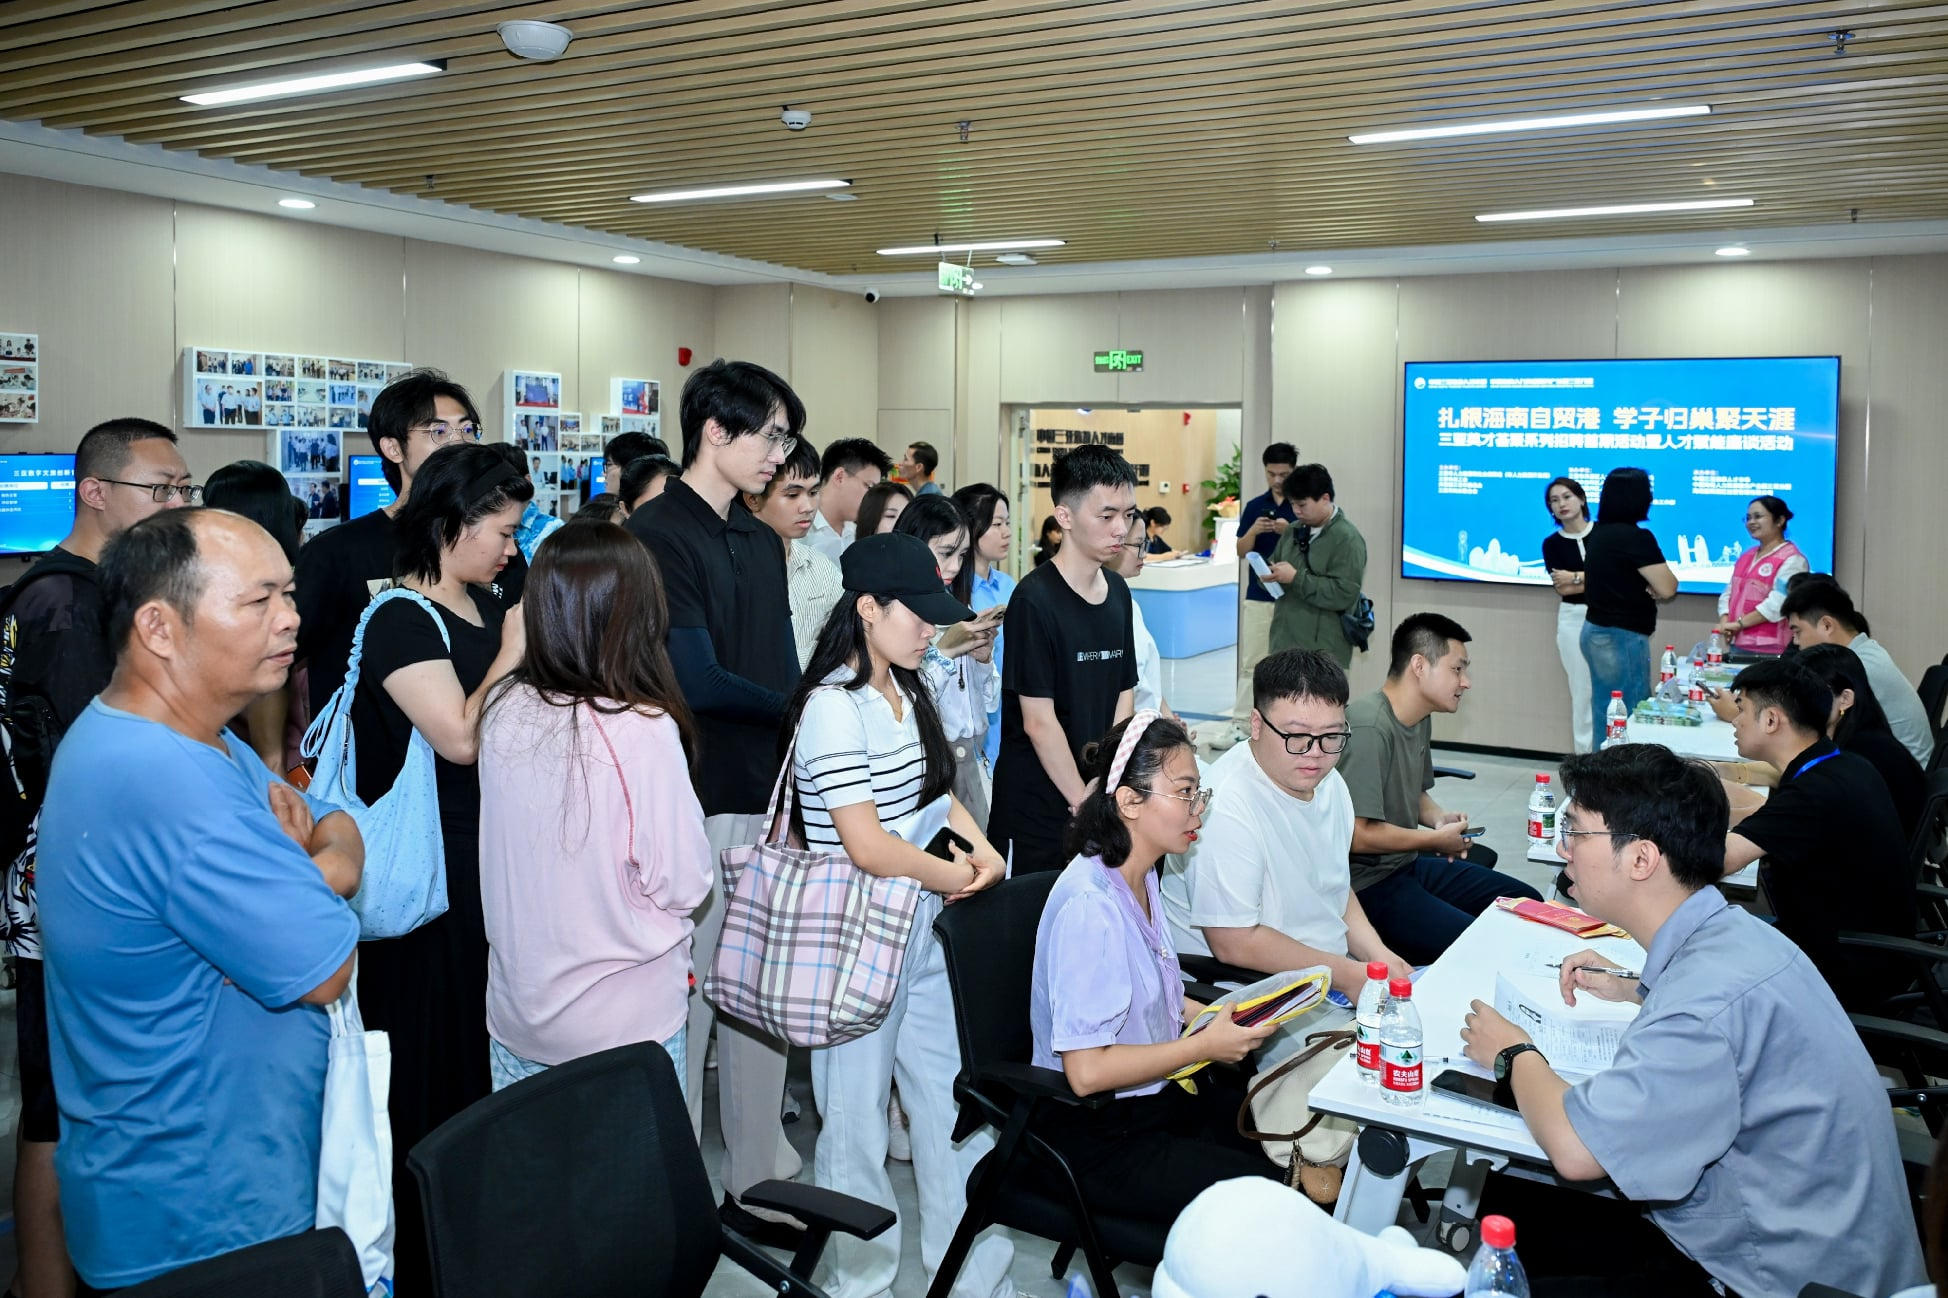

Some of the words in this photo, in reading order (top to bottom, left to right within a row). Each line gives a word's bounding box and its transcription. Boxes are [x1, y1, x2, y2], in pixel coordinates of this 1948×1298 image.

[1438, 407, 1600, 429] 扎根海南自贸港
[1613, 407, 1796, 430] 学子归巢聚天涯
